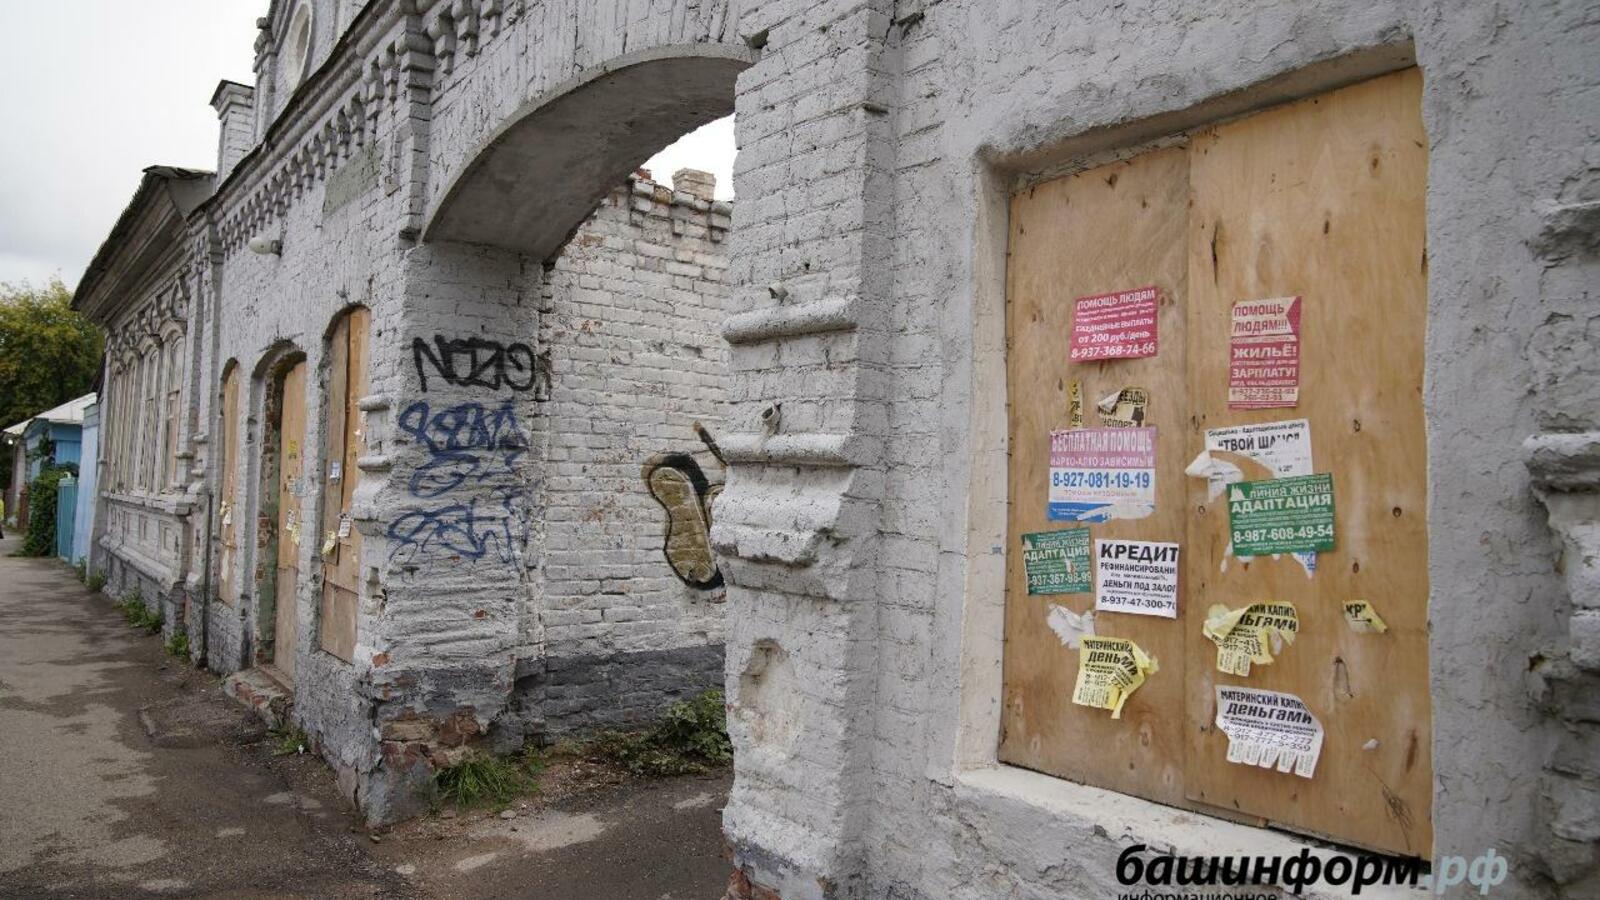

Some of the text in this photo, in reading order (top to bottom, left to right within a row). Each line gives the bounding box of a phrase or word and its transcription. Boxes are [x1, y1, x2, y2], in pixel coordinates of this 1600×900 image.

[1077, 296, 1118, 310] ПОМОЩЬ
[1120, 290, 1155, 304] ЛЮДЯМ
[1234, 304, 1285, 317] ПОМОЩЬ
[1091, 333, 1109, 343] 200
[1071, 342, 1155, 358] 8-937-368-74-66
[1110, 430, 1152, 455] ПОМОЩЬ
[1053, 472, 1150, 488] 8-927-081-19-19
[1290, 483, 1330, 496] ЖИЗНИ
[1232, 494, 1331, 514] АДАПТАЦИЯ
[1234, 524, 1333, 543] 8-987-608-49-54
[1024, 546, 1090, 563] АДАПТАЦИЯ
[1101, 543, 1178, 564] КРЕДИТ
[1103, 579, 1132, 589] ДЕНЬГИ
[1134, 581, 1150, 591] ПОД
[1221, 690, 1278, 707] МАТЕРИНСКИЙ
